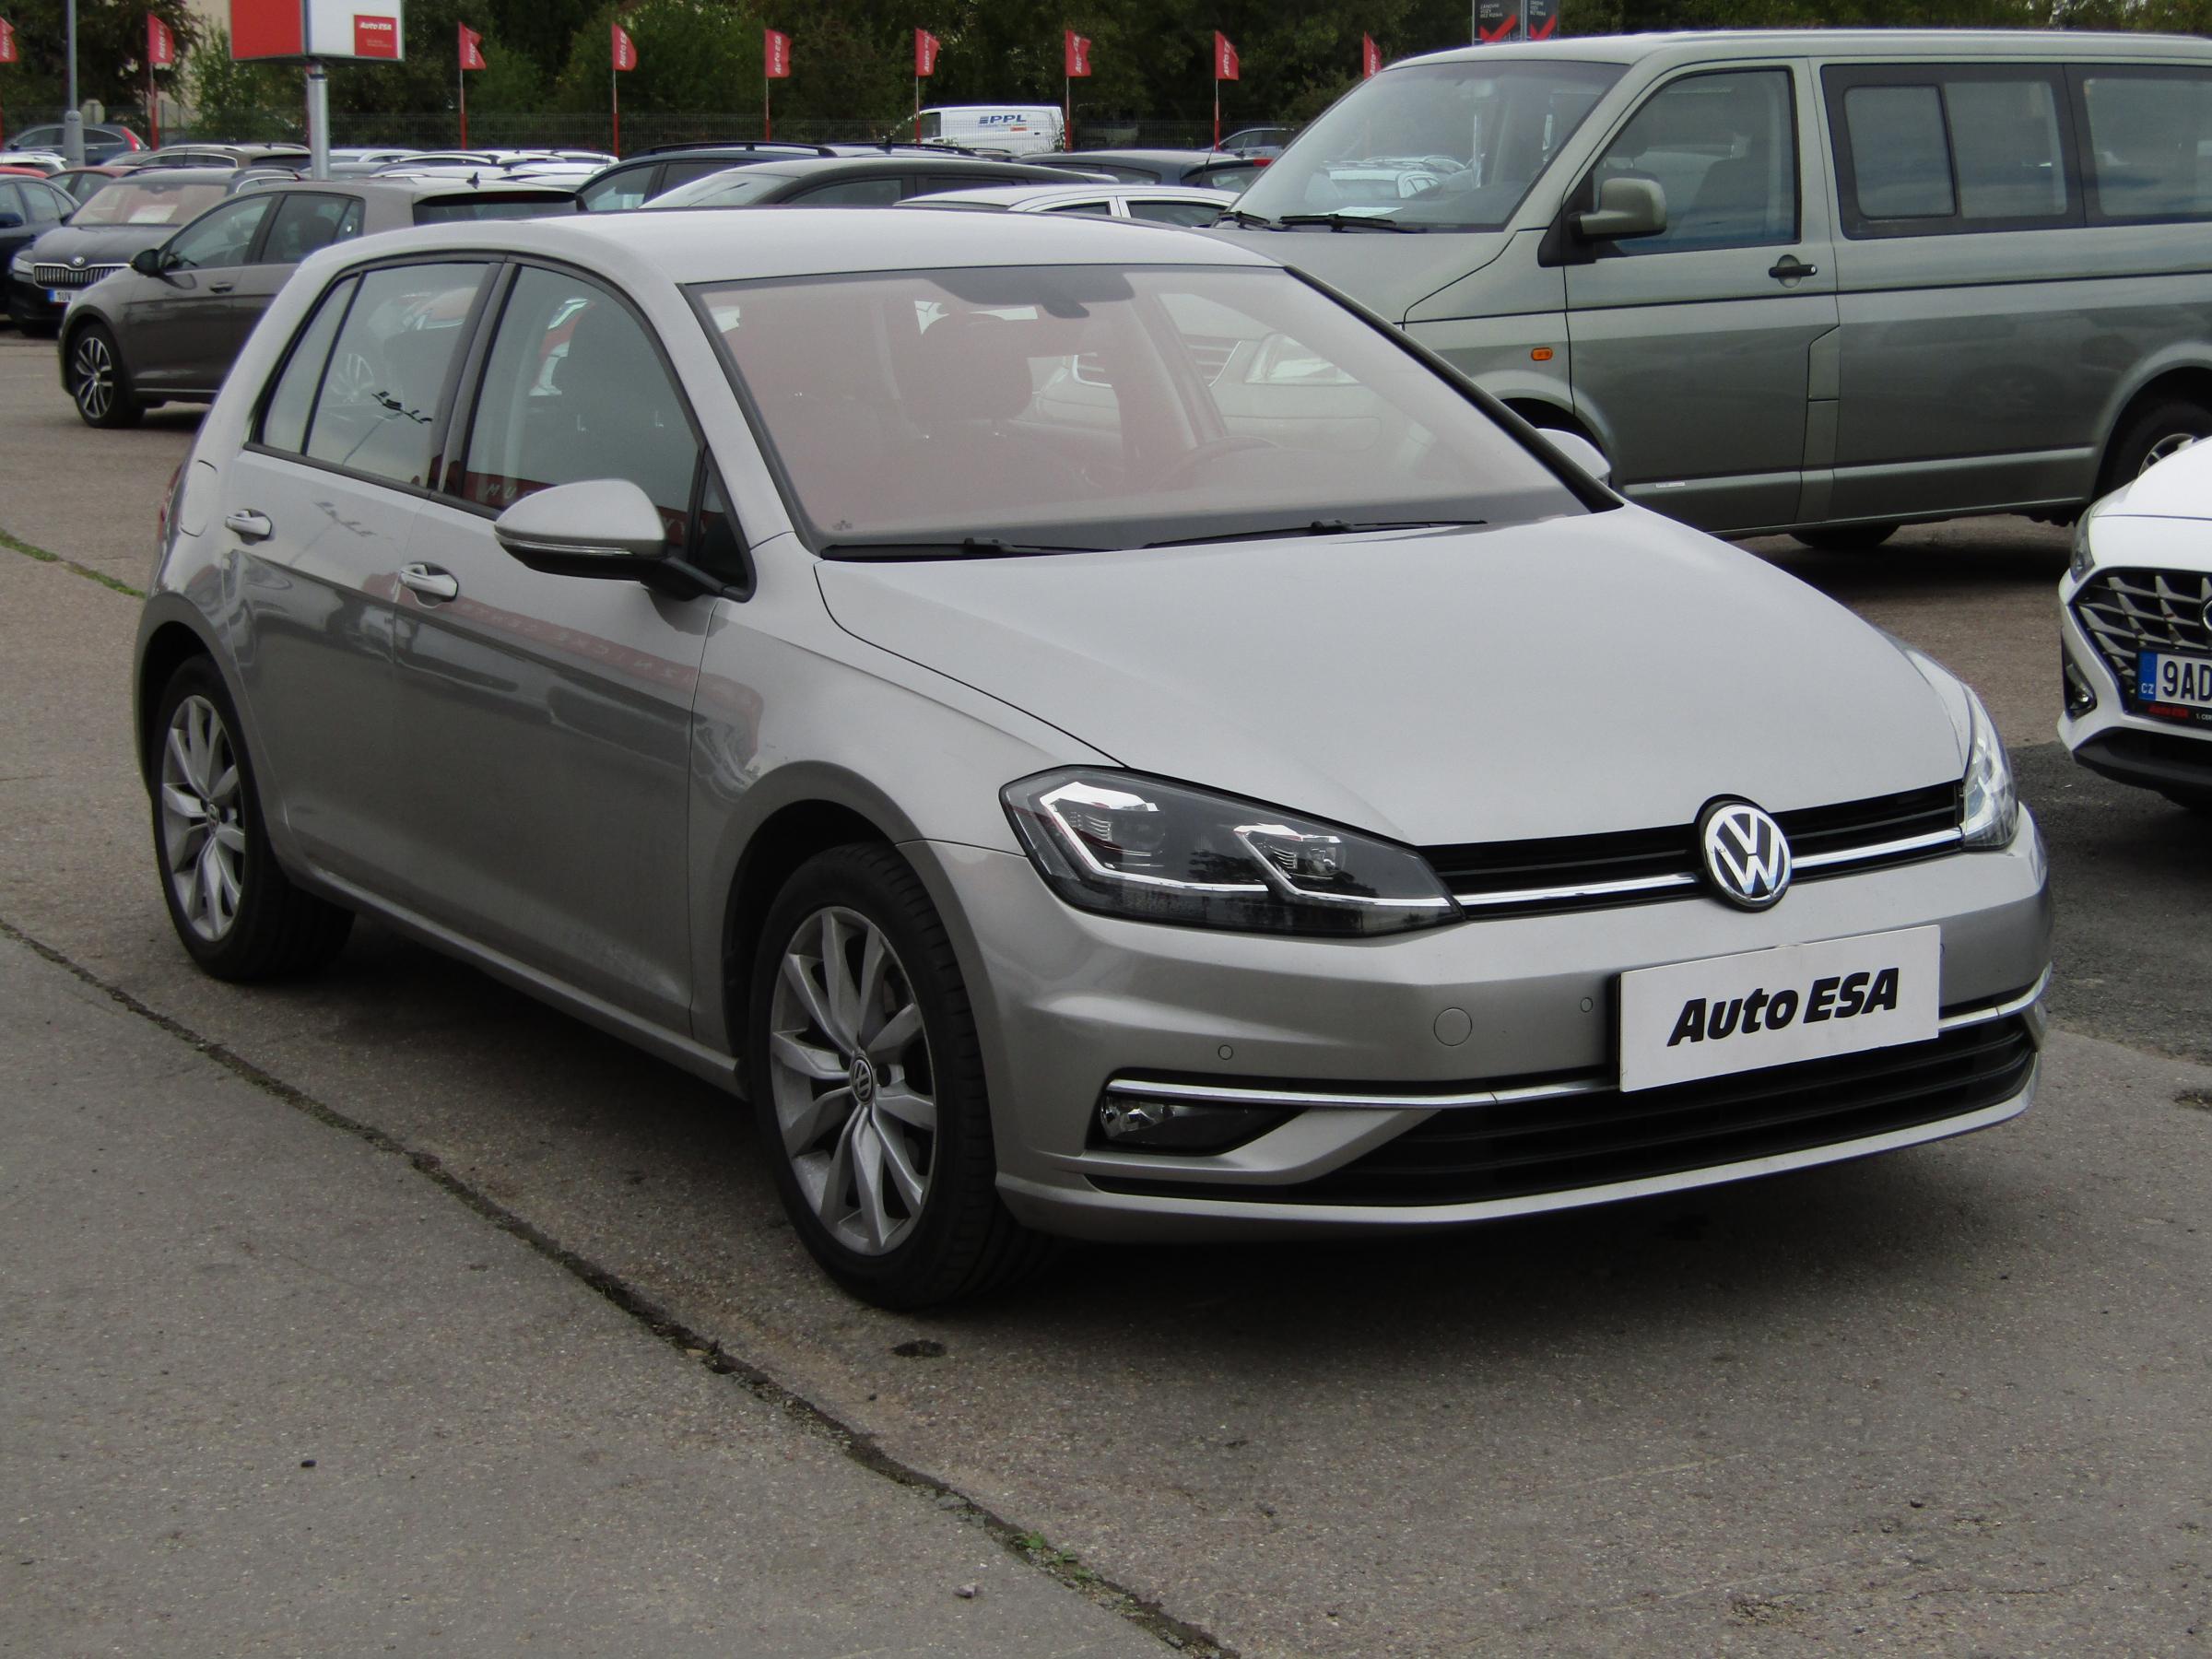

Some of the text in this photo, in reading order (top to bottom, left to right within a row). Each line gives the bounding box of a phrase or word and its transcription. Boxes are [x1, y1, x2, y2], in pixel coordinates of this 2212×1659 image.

[2141, 683, 2154, 694] CZ
[2162, 660, 2212, 701] 9AD
[1666, 967, 1900, 1047] Auto ESA
